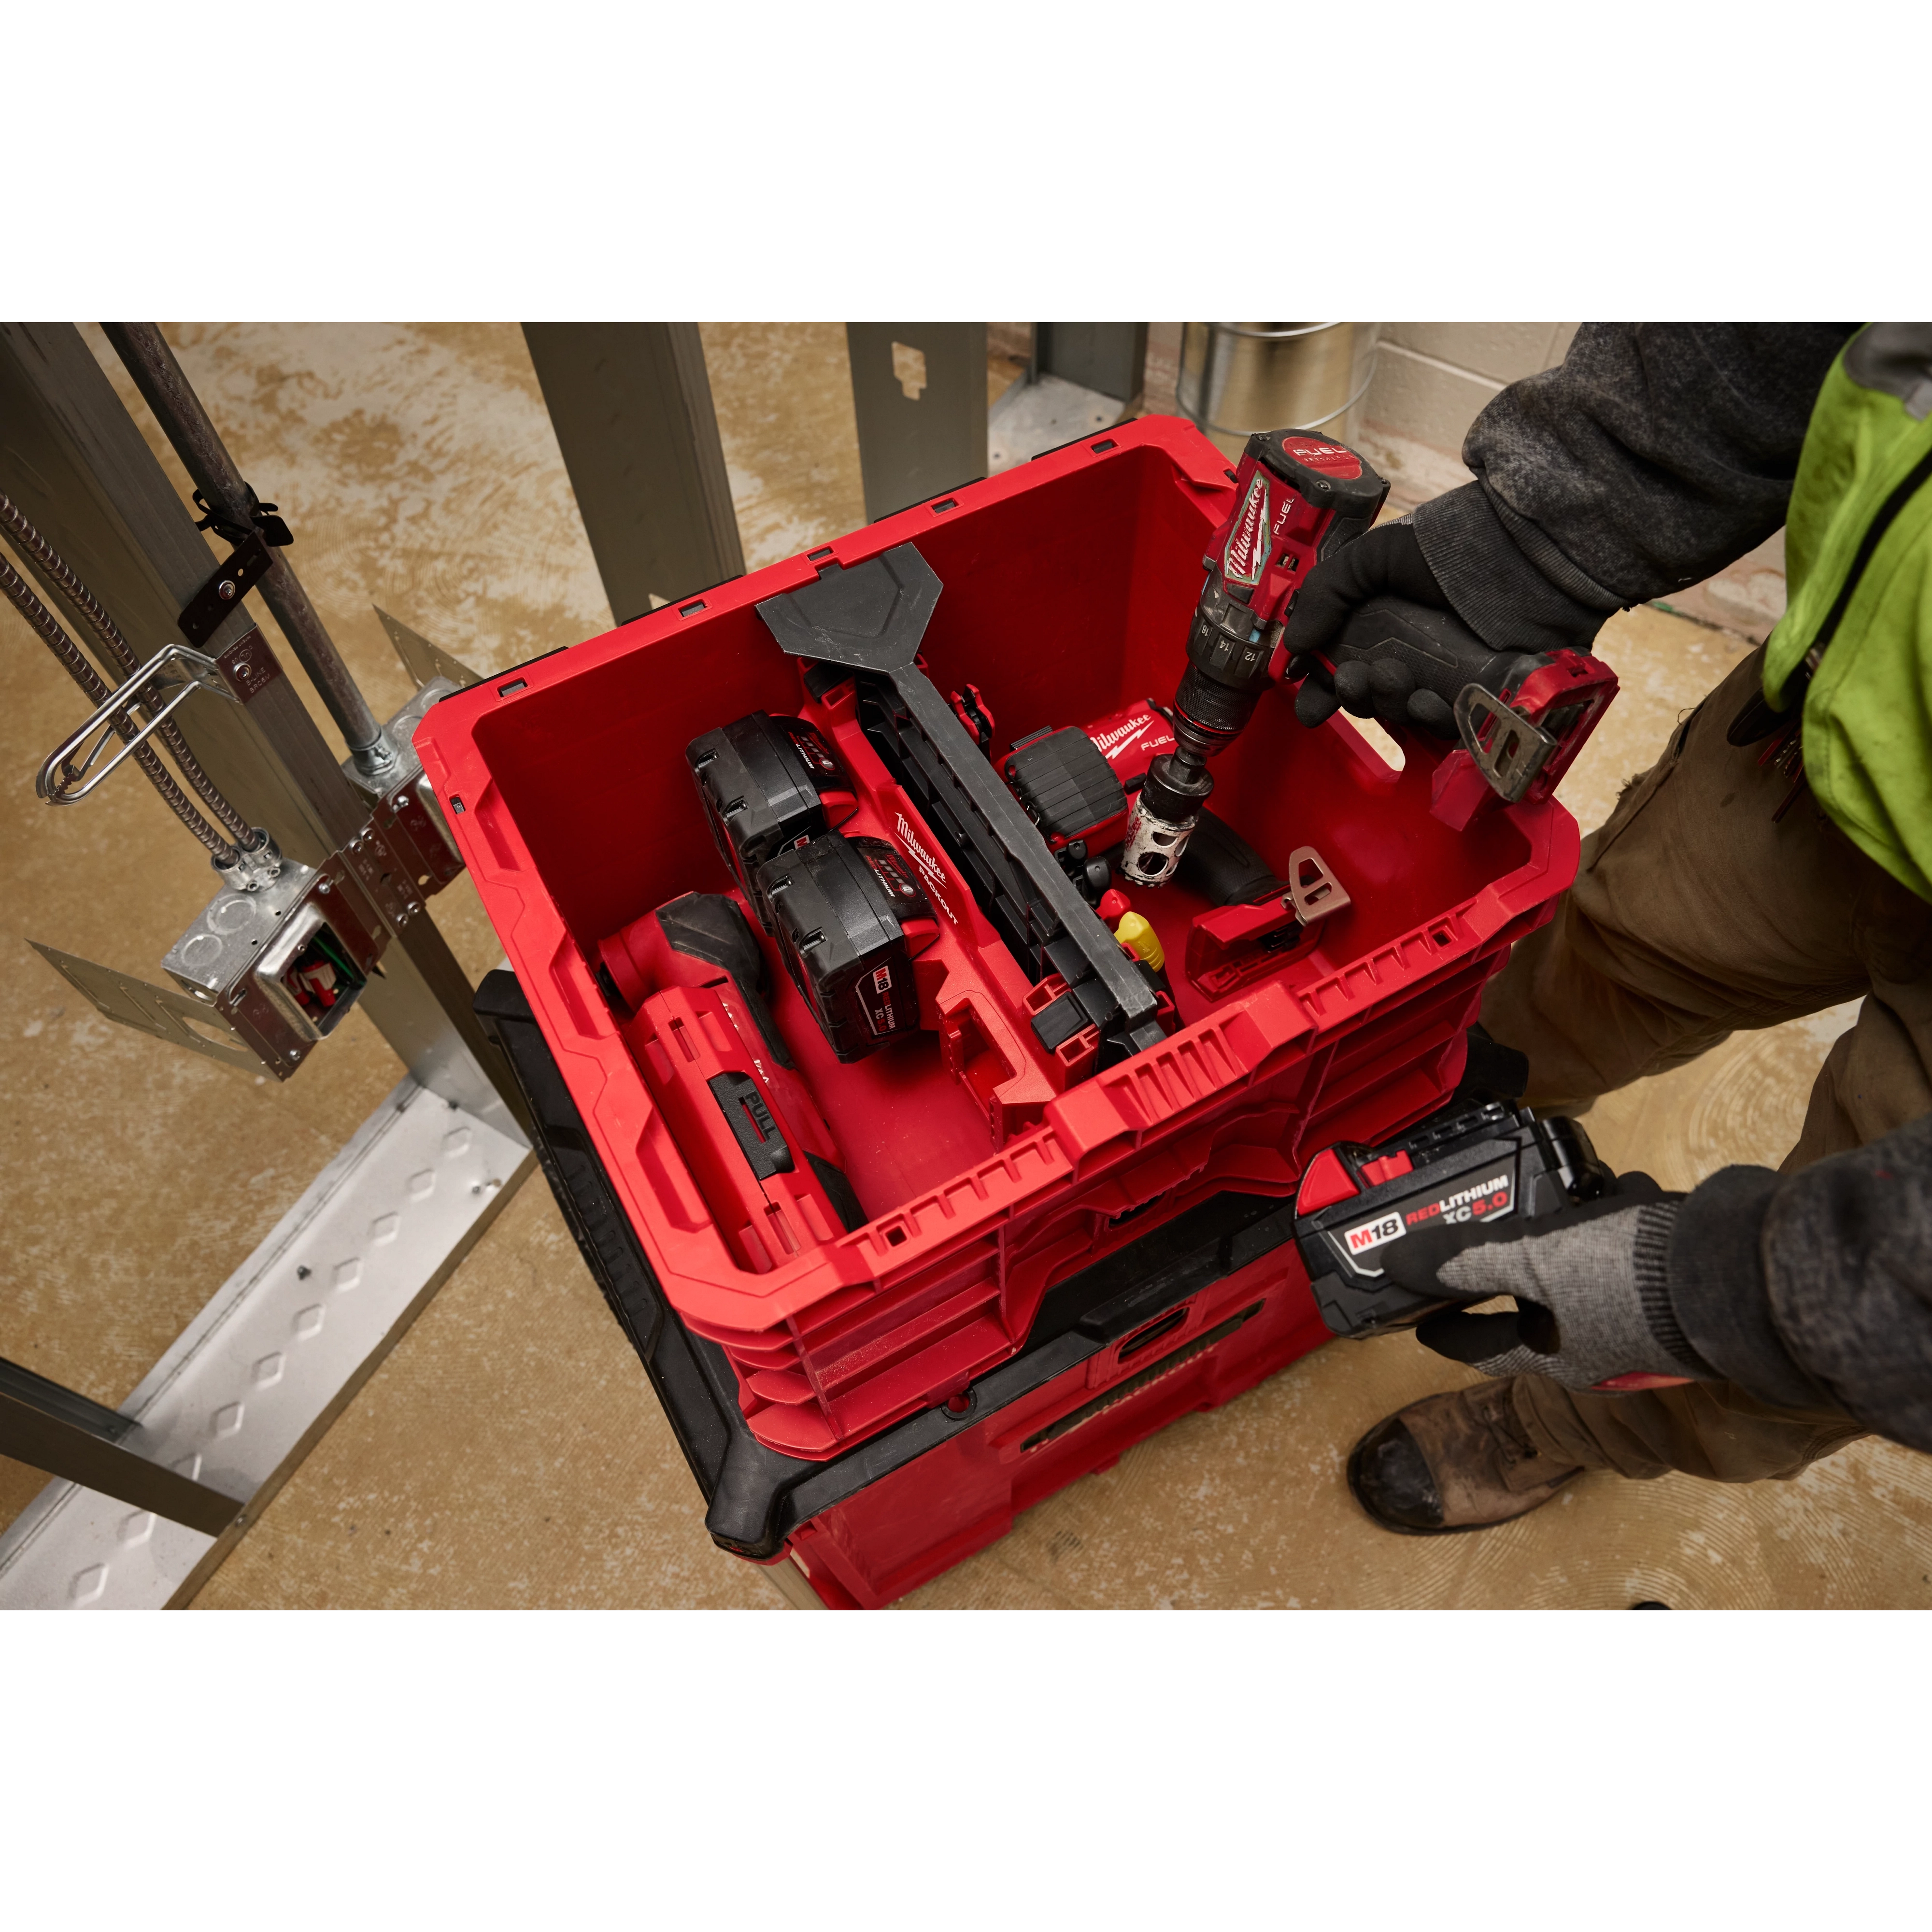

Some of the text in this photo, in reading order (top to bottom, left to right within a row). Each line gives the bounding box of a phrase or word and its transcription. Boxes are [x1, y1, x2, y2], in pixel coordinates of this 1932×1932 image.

[1293, 447, 1348, 457] FUEL
[1226, 479, 1263, 579] Milwaukee
[1273, 497, 1295, 535] FUEL
[1201, 625, 1209, 637] 16
[1219, 640, 1230, 651] 14
[1244, 652, 1256, 661] 12
[245, 667, 266, 686] B-LINE
[249, 673, 271, 694] BRC6M
[1140, 735, 1175, 751] FUEL
[895, 812, 947, 883] Milwaukee
[919, 865, 958, 925] PACKOUT
[875, 967, 889, 991] M18
[881, 991, 896, 1029] REDLITHIUM
[744, 1091, 775, 1140] PULL
[1406, 1174, 1509, 1226] REDLITHIUM
[1350, 1219, 1399, 1249] M18
